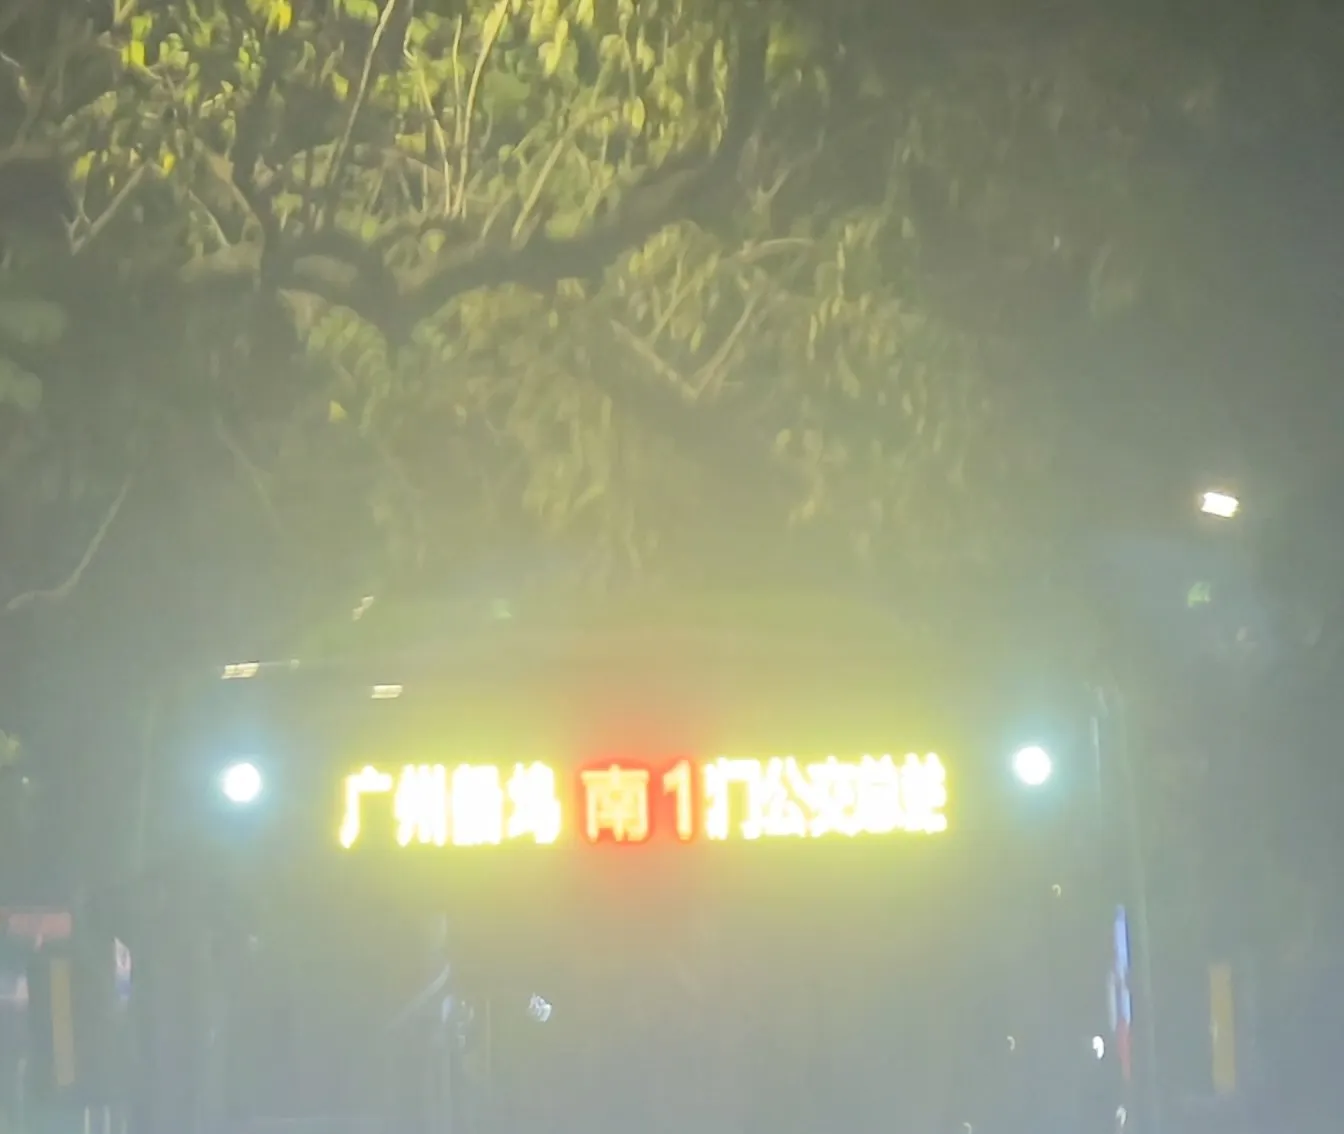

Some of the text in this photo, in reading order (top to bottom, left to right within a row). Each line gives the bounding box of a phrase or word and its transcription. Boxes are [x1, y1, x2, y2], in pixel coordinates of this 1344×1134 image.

[580, 759, 693, 842] 南1
[703, 752, 947, 841] 门公交总站
